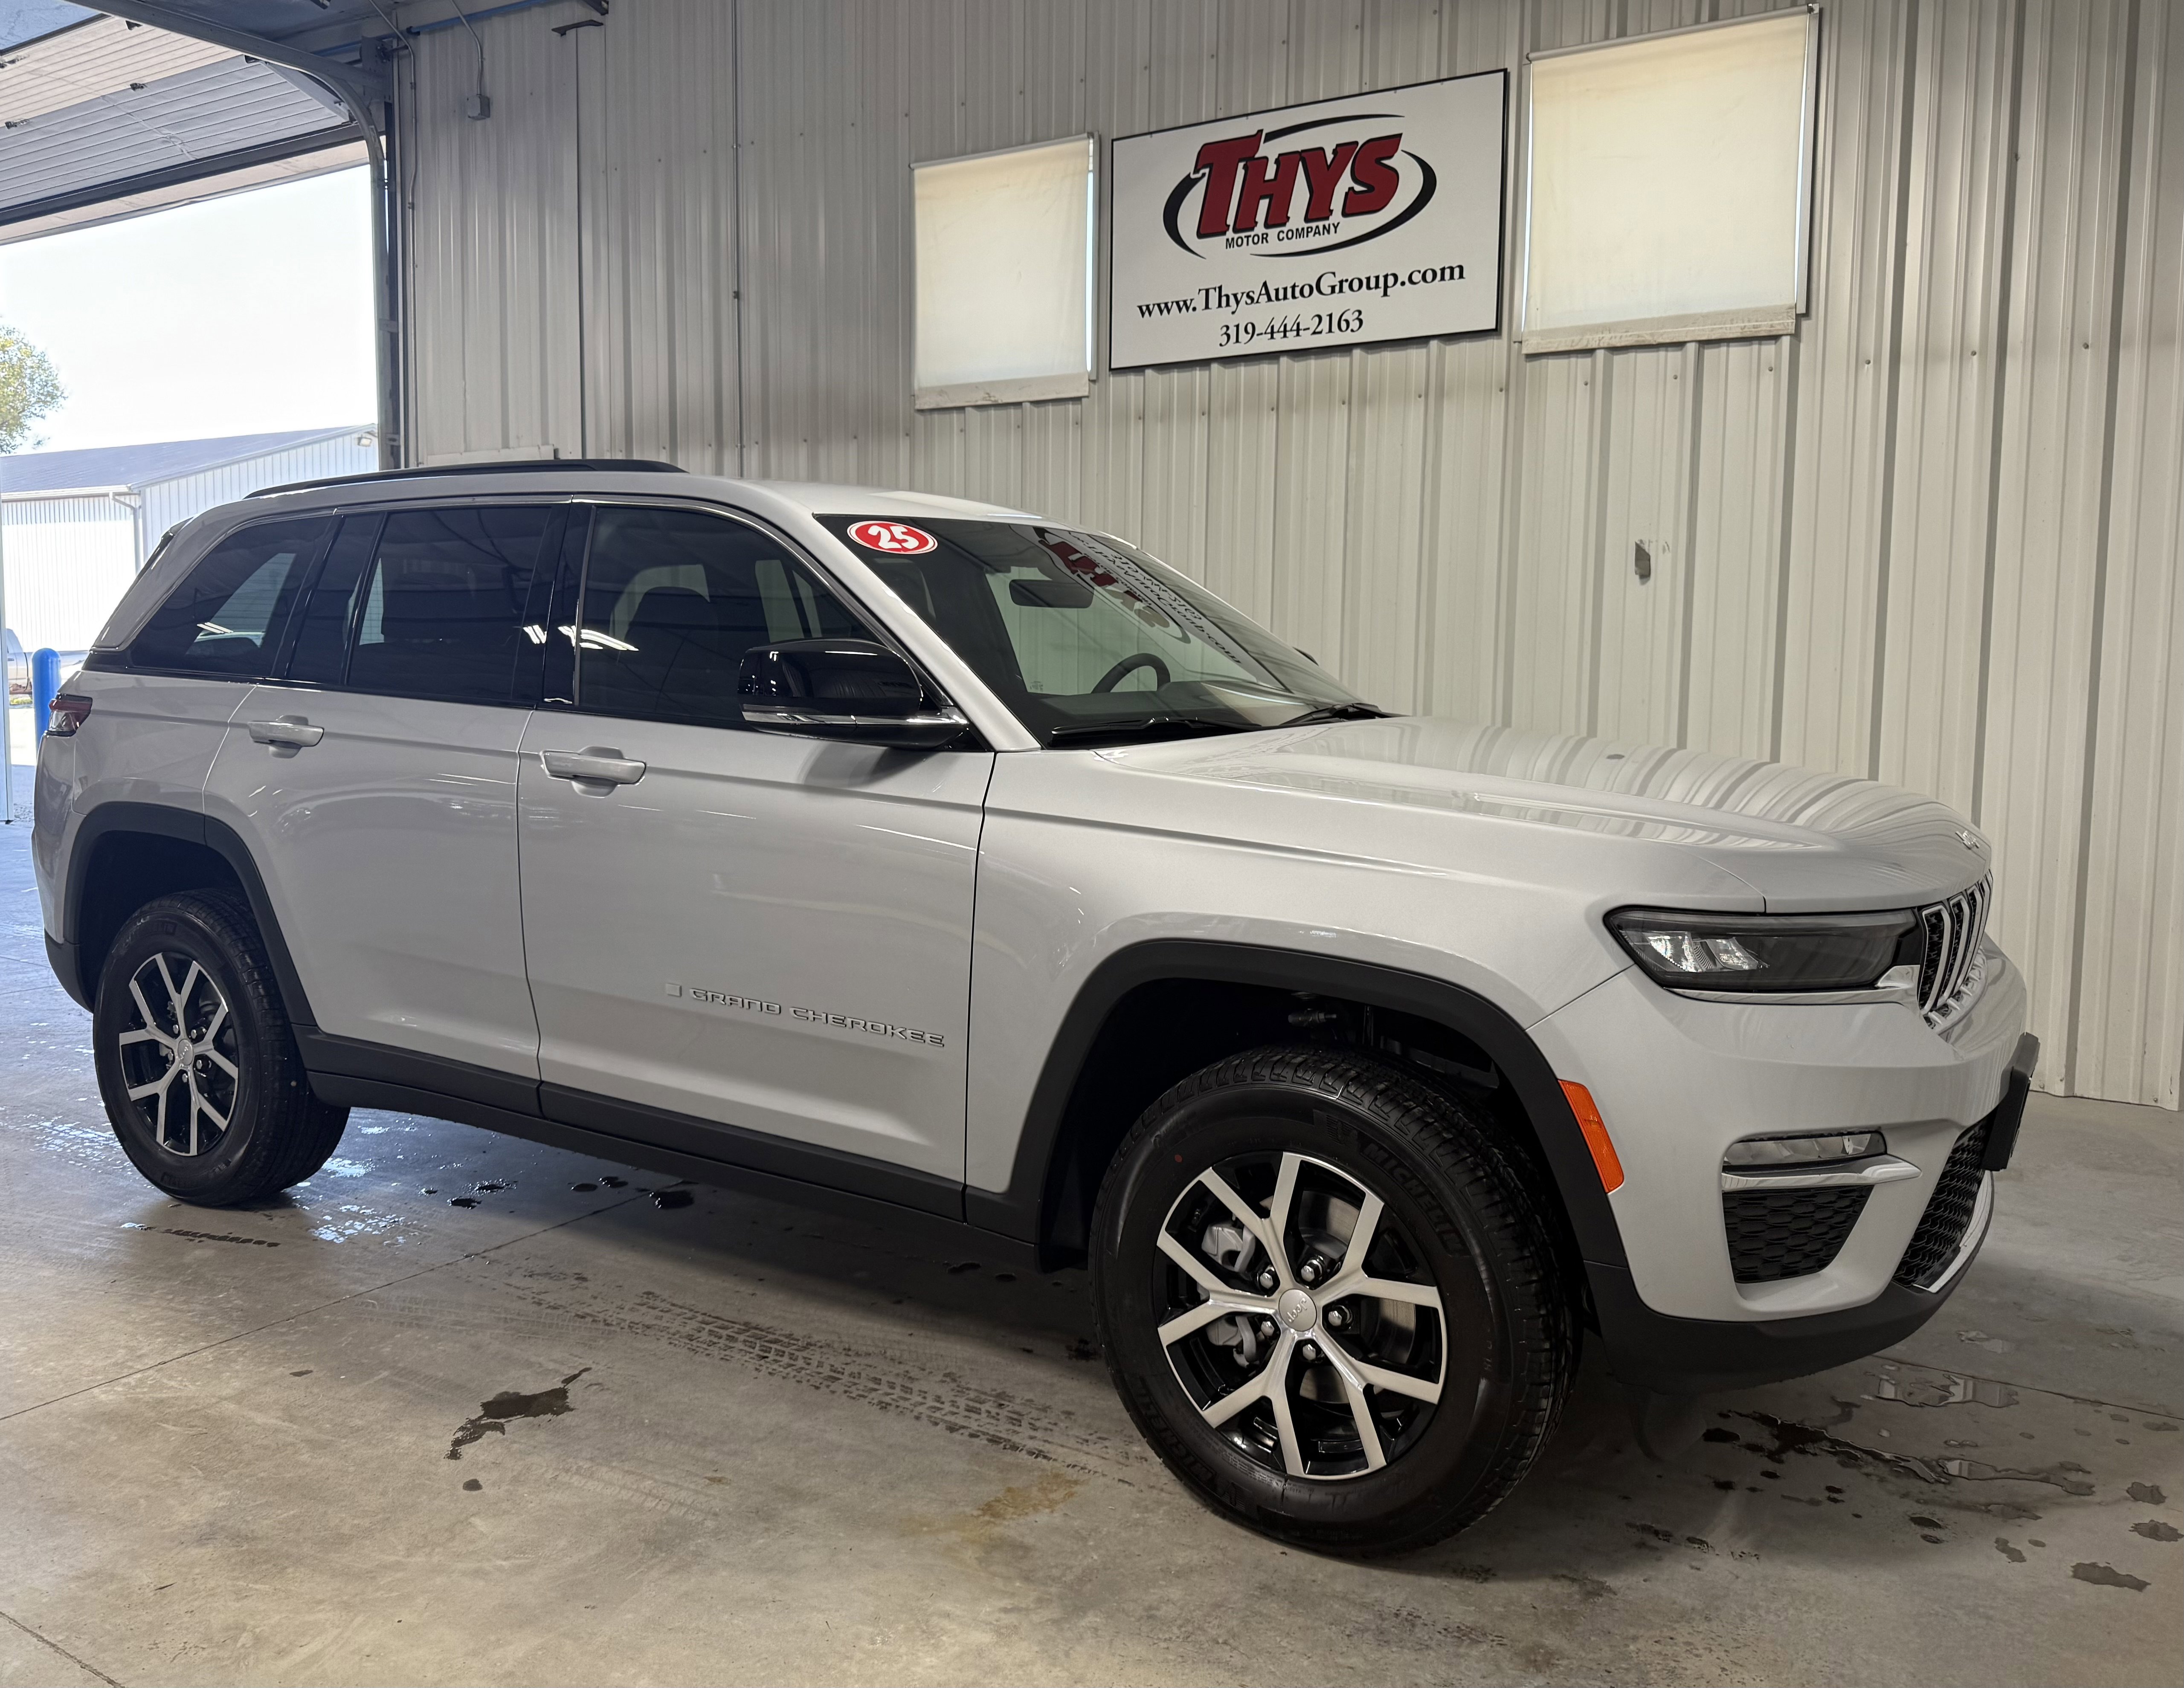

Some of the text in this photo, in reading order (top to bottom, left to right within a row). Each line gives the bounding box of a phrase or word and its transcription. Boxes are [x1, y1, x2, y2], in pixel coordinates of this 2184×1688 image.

[1193, 129, 1403, 239] THYS
[1225, 222, 1340, 249] MOTOR COMPANY
[1137, 264, 1466, 318] www.ThysAutoGroup.com
[1219, 308, 1363, 347] 319-444-2163
[868, 525, 919, 549] 25
[689, 987, 945, 1048] GRAND CHEROKEE
[1287, 1297, 1308, 1323] Jeep
